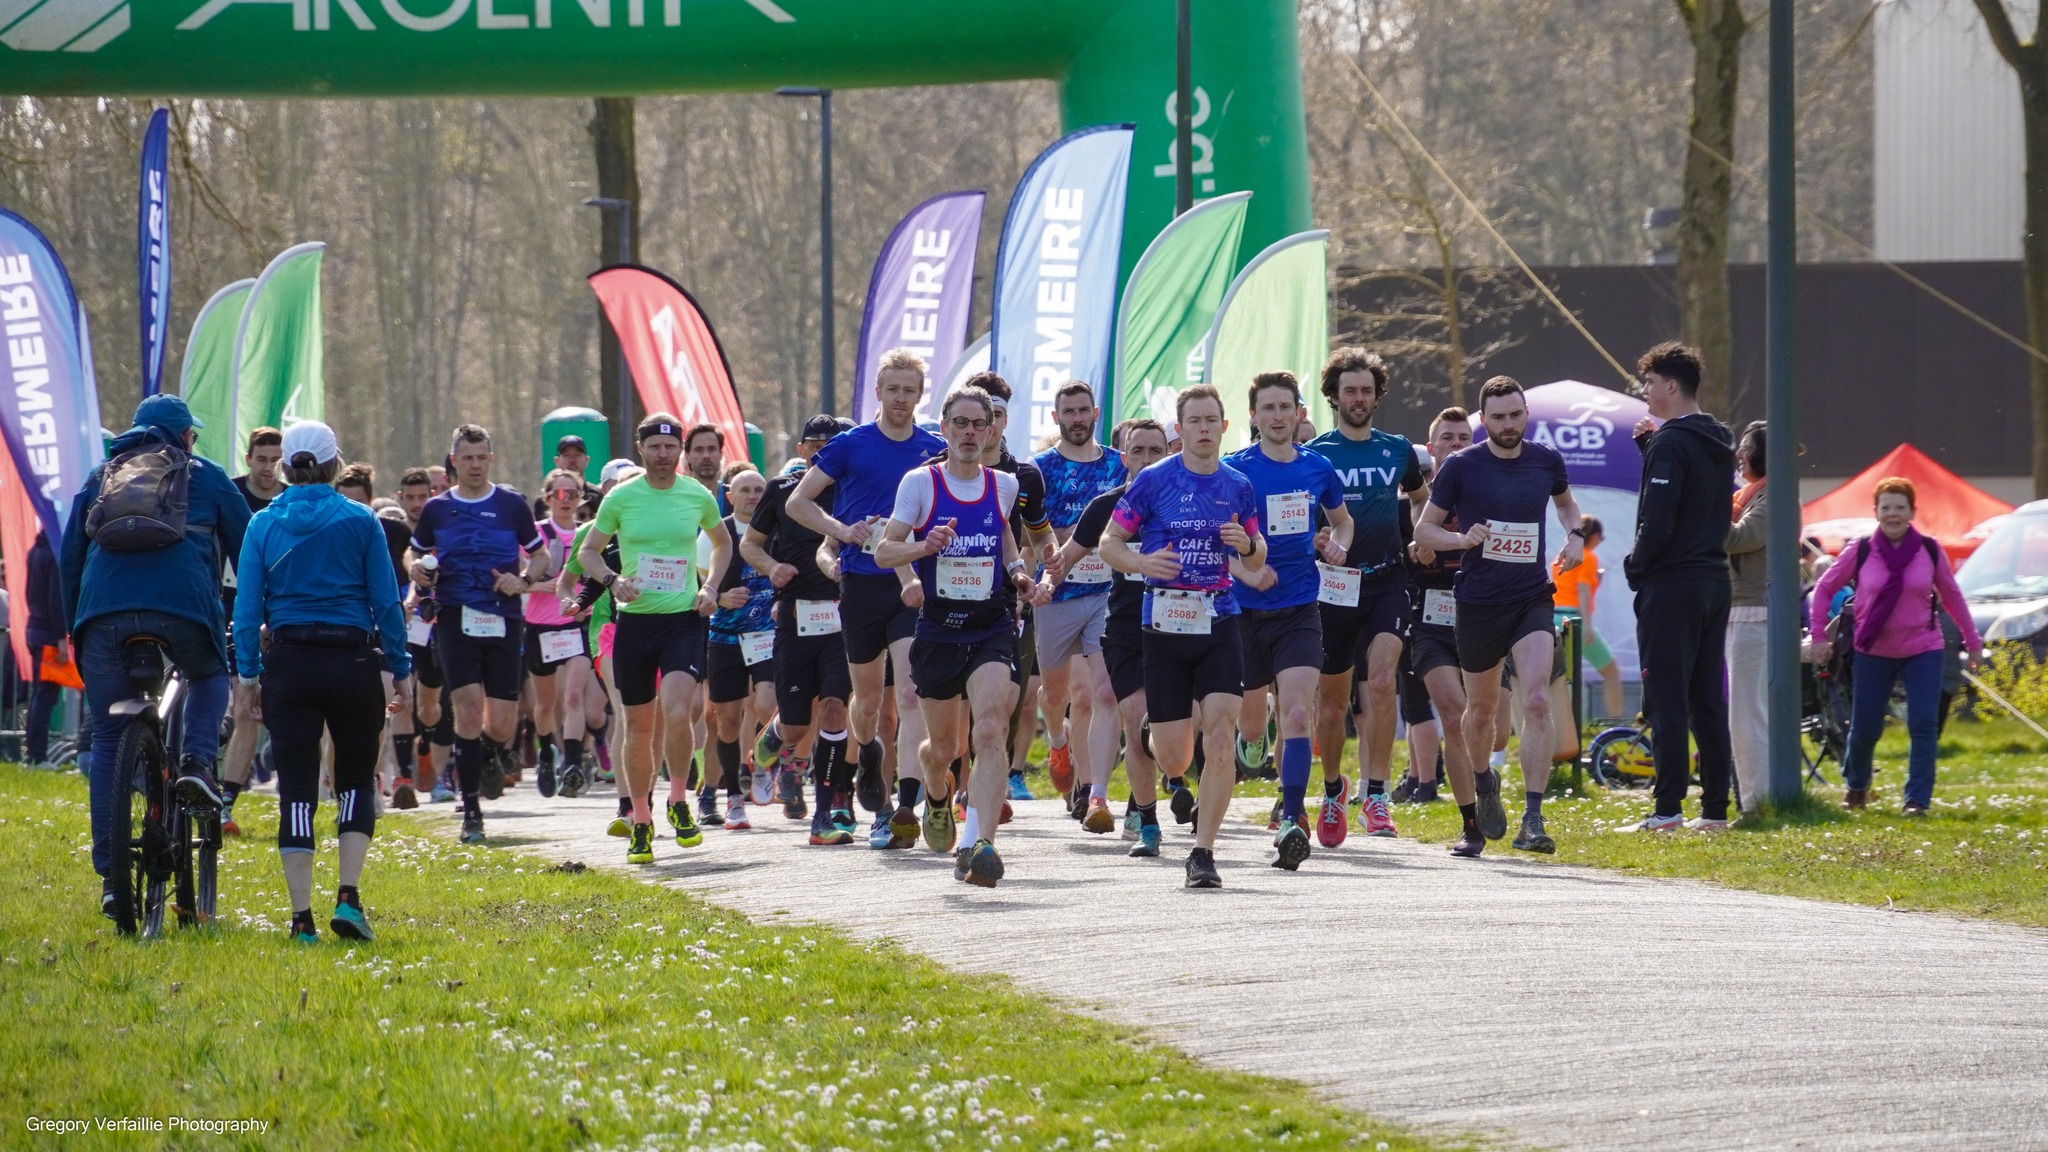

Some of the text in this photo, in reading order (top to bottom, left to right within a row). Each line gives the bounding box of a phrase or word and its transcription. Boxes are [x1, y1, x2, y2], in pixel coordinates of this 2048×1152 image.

[1281, 509, 1306, 519] 25143
[1171, 519, 1207, 530] margo
[1179, 536, 1212, 550] CAFÉ
[1492, 538, 1532, 554] 2425
[1180, 551, 1224, 565] VITESSE
[1080, 563, 1104, 571] 25044
[649, 570, 675, 580] 25118
[951, 577, 981, 586] 25136
[1324, 579, 1346, 591] 25049
[1438, 604, 1456, 613] 251
[809, 612, 835, 621] 25181
[1167, 609, 1197, 619] 25082
[753, 642, 774, 652] 2504
